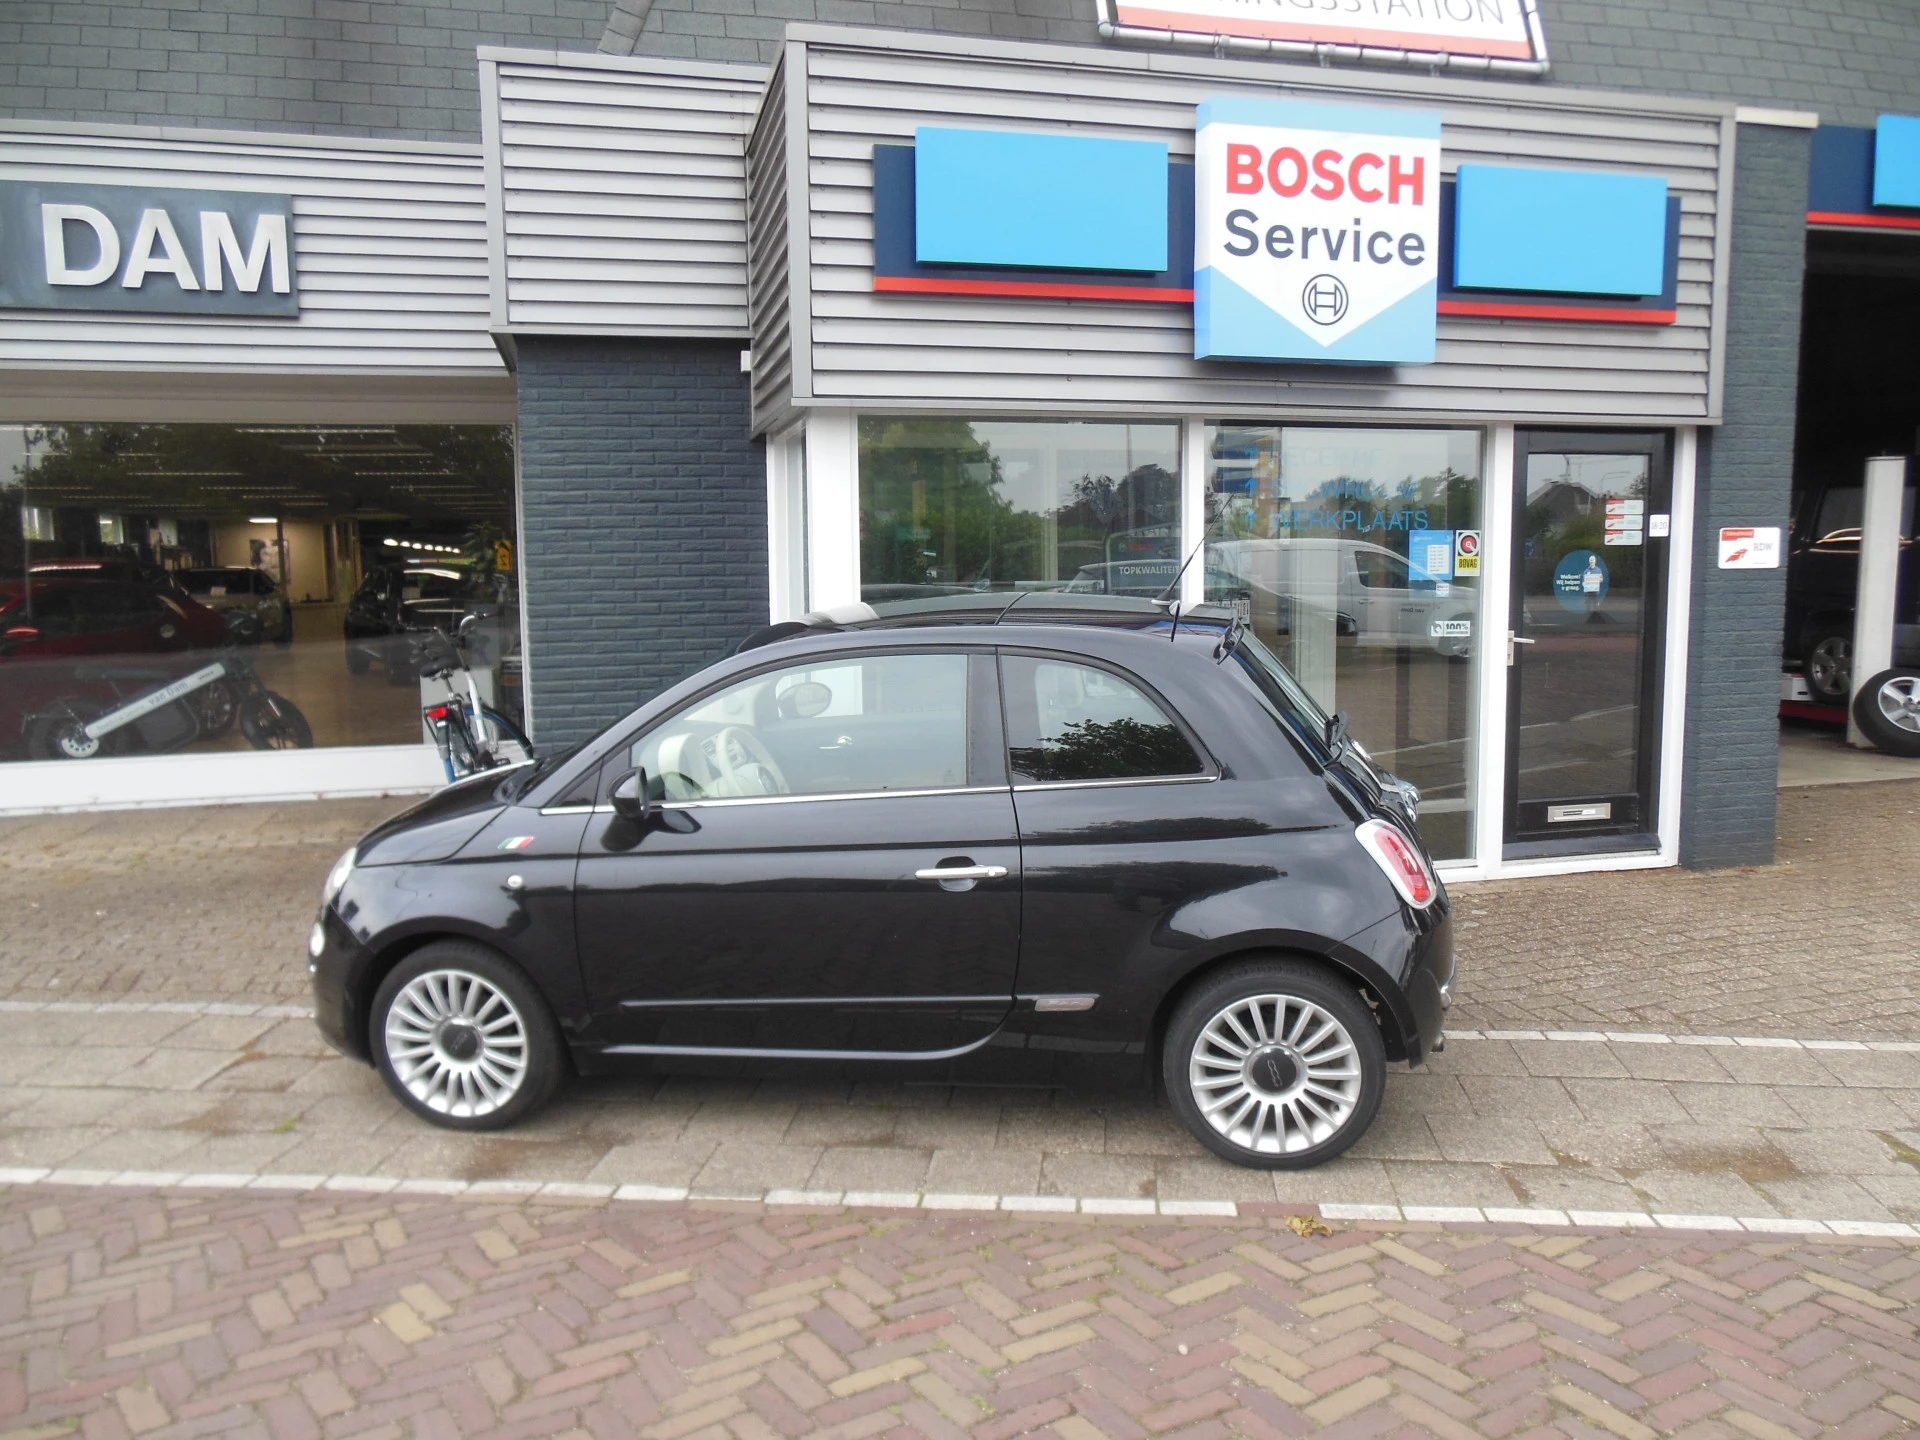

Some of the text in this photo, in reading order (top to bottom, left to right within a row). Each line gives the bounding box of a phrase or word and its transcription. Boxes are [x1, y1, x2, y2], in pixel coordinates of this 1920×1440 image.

[1226, 143, 1425, 206] BOSCH
[41, 203, 290, 294] DAM
[1223, 208, 1426, 267] Service
[1271, 510, 1429, 531] WERKPLAATS
